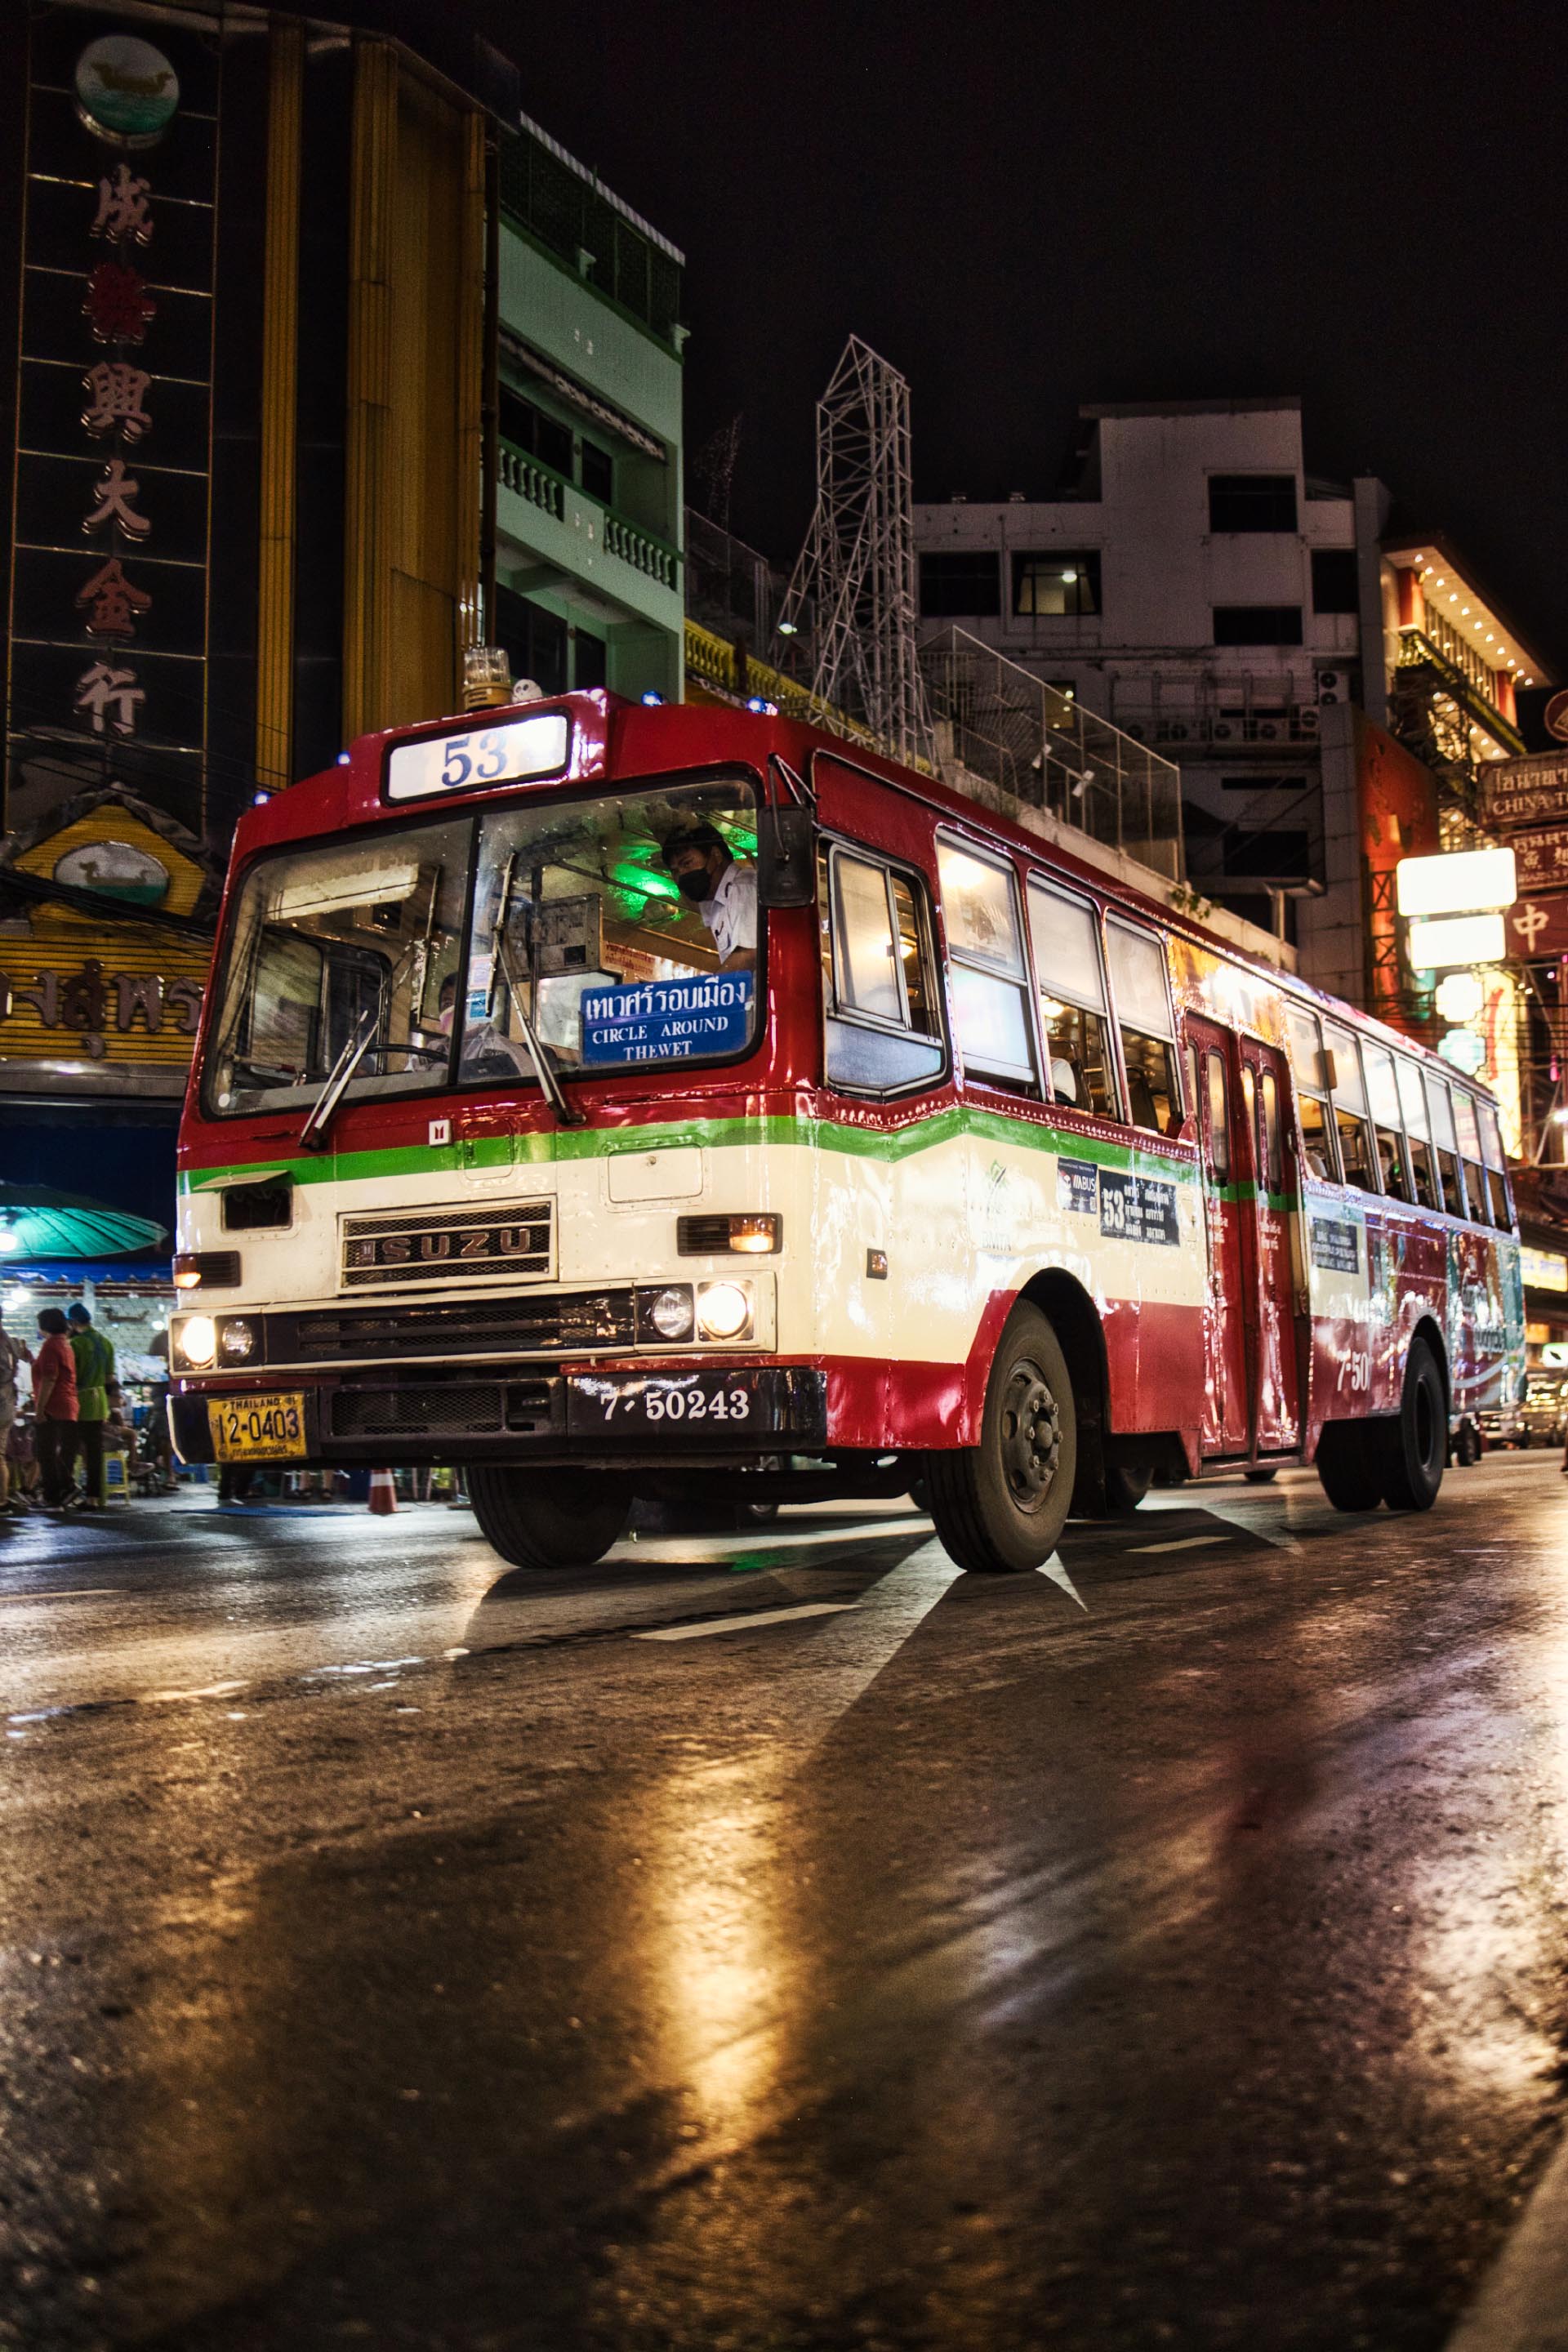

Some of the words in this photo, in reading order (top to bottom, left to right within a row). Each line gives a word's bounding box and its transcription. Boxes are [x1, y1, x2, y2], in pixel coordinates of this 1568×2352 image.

[442, 731, 509, 786] 53
[1493, 795, 1549, 815] CHINA
[1512, 903, 1549, 953] 中
[592, 1025, 648, 1045] CIRCLE
[661, 1016, 728, 1037] AROUND
[623, 1040, 693, 1061] THEWET
[1103, 1187, 1125, 1230] 53
[357, 1227, 531, 1267] ISUZU
[230, 1397, 280, 1410] THAILAND
[218, 1408, 299, 1444] 12-0403
